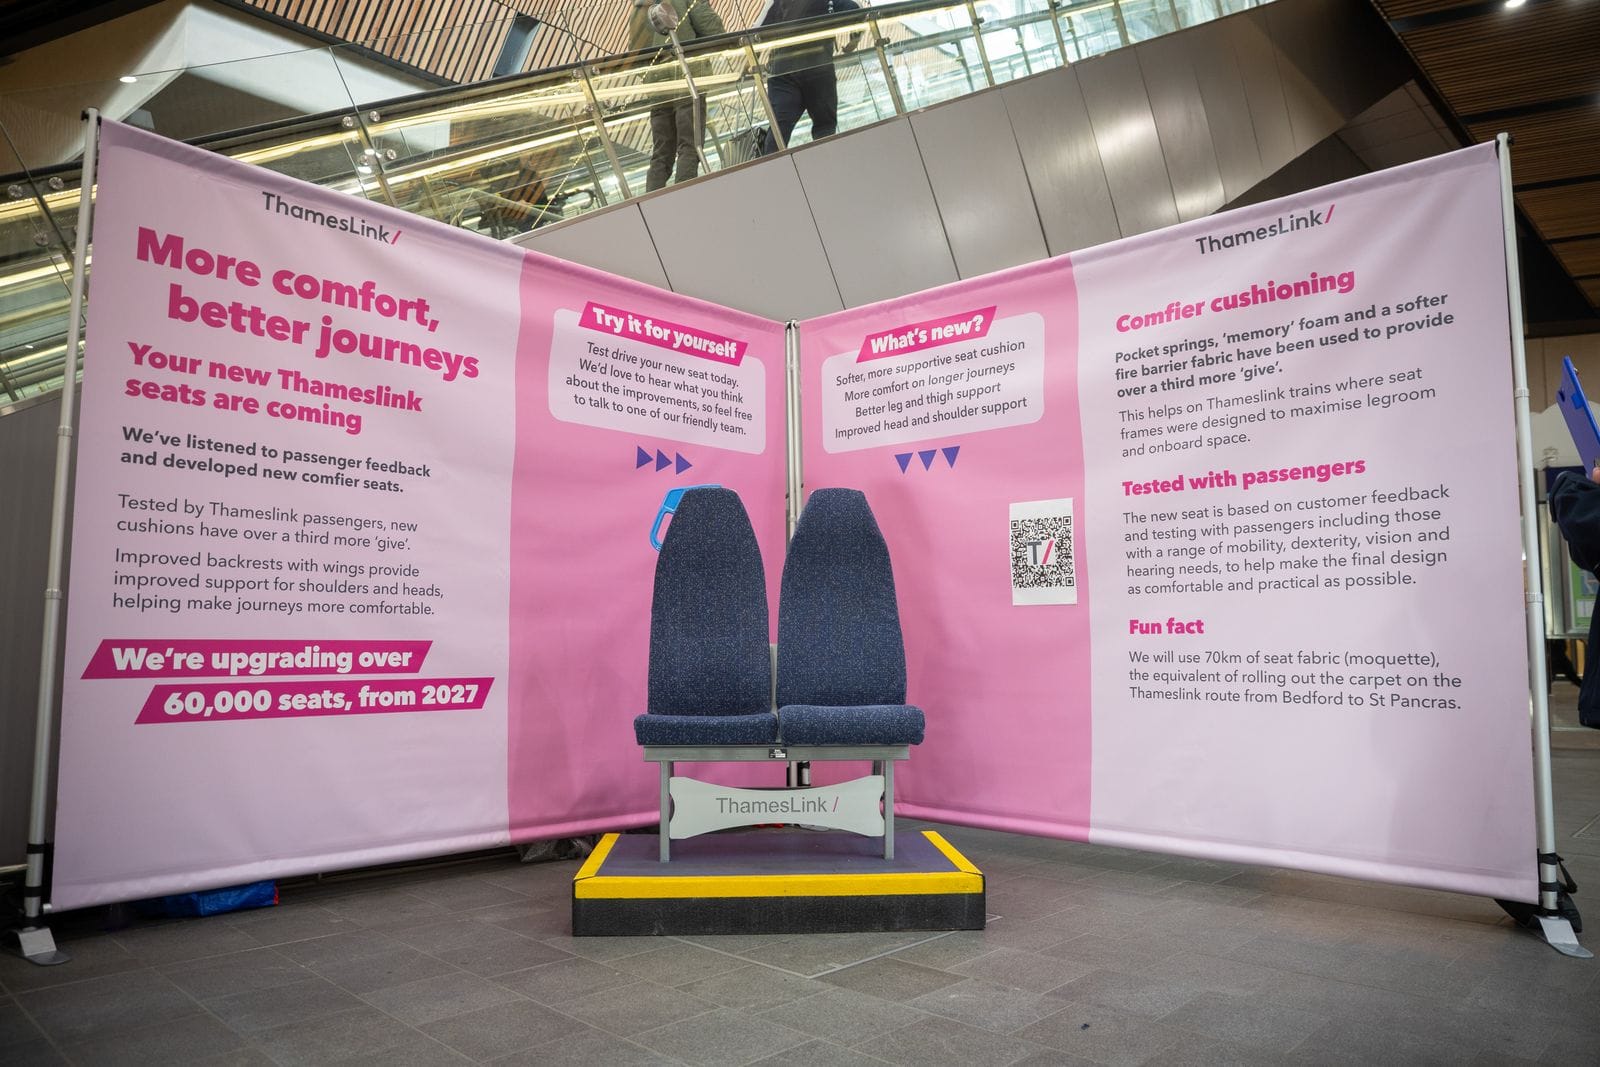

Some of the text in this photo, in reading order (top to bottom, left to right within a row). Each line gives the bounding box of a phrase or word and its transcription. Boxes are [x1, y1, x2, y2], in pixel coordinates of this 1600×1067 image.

[137, 226, 440, 333] More comfort,
[1116, 271, 1355, 332] Comfier cushioning
[168, 283, 479, 382] better journeys
[592, 307, 737, 359] Try it for yourself
[870, 314, 984, 354] What's new?
[1115, 294, 1448, 363] Pocket springs, 'memory' foam and a softer
[1115, 312, 1454, 381] fire barrier fabric have been used to provide
[127, 341, 423, 412] Your new Thameslink
[587, 341, 739, 390] Test drive your new seat today.
[610, 364, 632, 381] love
[634, 372, 646, 384] to
[648, 373, 672, 389] hear
[673, 380, 699, 395] what
[700, 387, 719, 399] you
[720, 389, 743, 404] think
[836, 341, 1025, 386] Softer, more supportive seat cushion
[844, 362, 1015, 403] More comfort on longer journeys
[124, 379, 362, 435] seats are coming
[566, 374, 752, 421] about the improvements, so feel free
[1118, 368, 1423, 422] This helps on Thameslink trains where seat
[835, 397, 1027, 439] Improved head and shoulder support
[122, 426, 430, 477] We've listened to passenger feedback
[1122, 433, 1251, 458] and onboard space.
[120, 451, 403, 493] and developed new comfier seats.
[1122, 460, 1366, 496] Tested with passengers
[118, 494, 418, 532] Tested by Thameslink passengers, new
[1122, 483, 1450, 524] The new seat is based on customer feedback
[116, 548, 420, 579] Improved backrests with wings provide
[1125, 526, 1450, 560] with a range of mobility, dexterity, vision and
[113, 592, 434, 616] helping make journeys more comfortable.
[1129, 617, 1204, 635] Fun fact
[112, 645, 413, 676] We're upgrading over
[1128, 650, 1440, 669] We will use 70km of seat fabric (moquette),
[164, 684, 479, 717] 60,000 seats, from 2027
[1129, 686, 1461, 709] Thameslink route from Bedford to St Pancras.
[715, 796, 827, 814] ThamesLink
